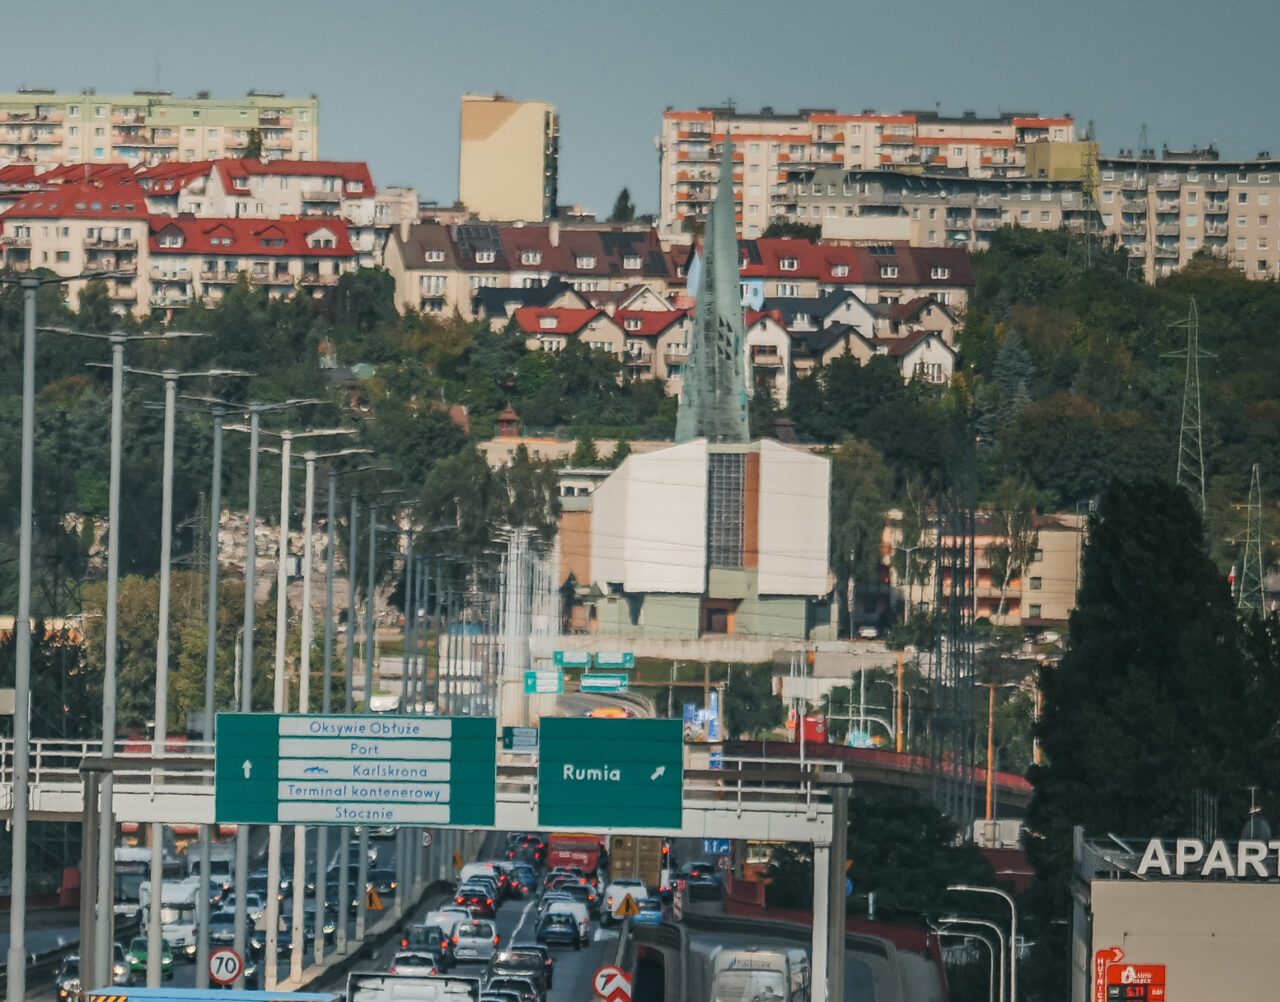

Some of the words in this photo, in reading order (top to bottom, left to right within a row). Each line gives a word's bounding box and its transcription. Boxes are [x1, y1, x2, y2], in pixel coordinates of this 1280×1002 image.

[309, 721, 367, 738] Oksywie
[369, 721, 420, 735] Obłuże
[350, 743, 379, 756] Port
[352, 764, 428, 778] Karlskrona
[563, 764, 621, 781] Rumia
[287, 784, 348, 798] Terminal
[351, 785, 440, 802] kontenerowy
[334, 807, 394, 820] Stocznie
[1136, 839, 1280, 877] APAR
[214, 956, 237, 975] 70
